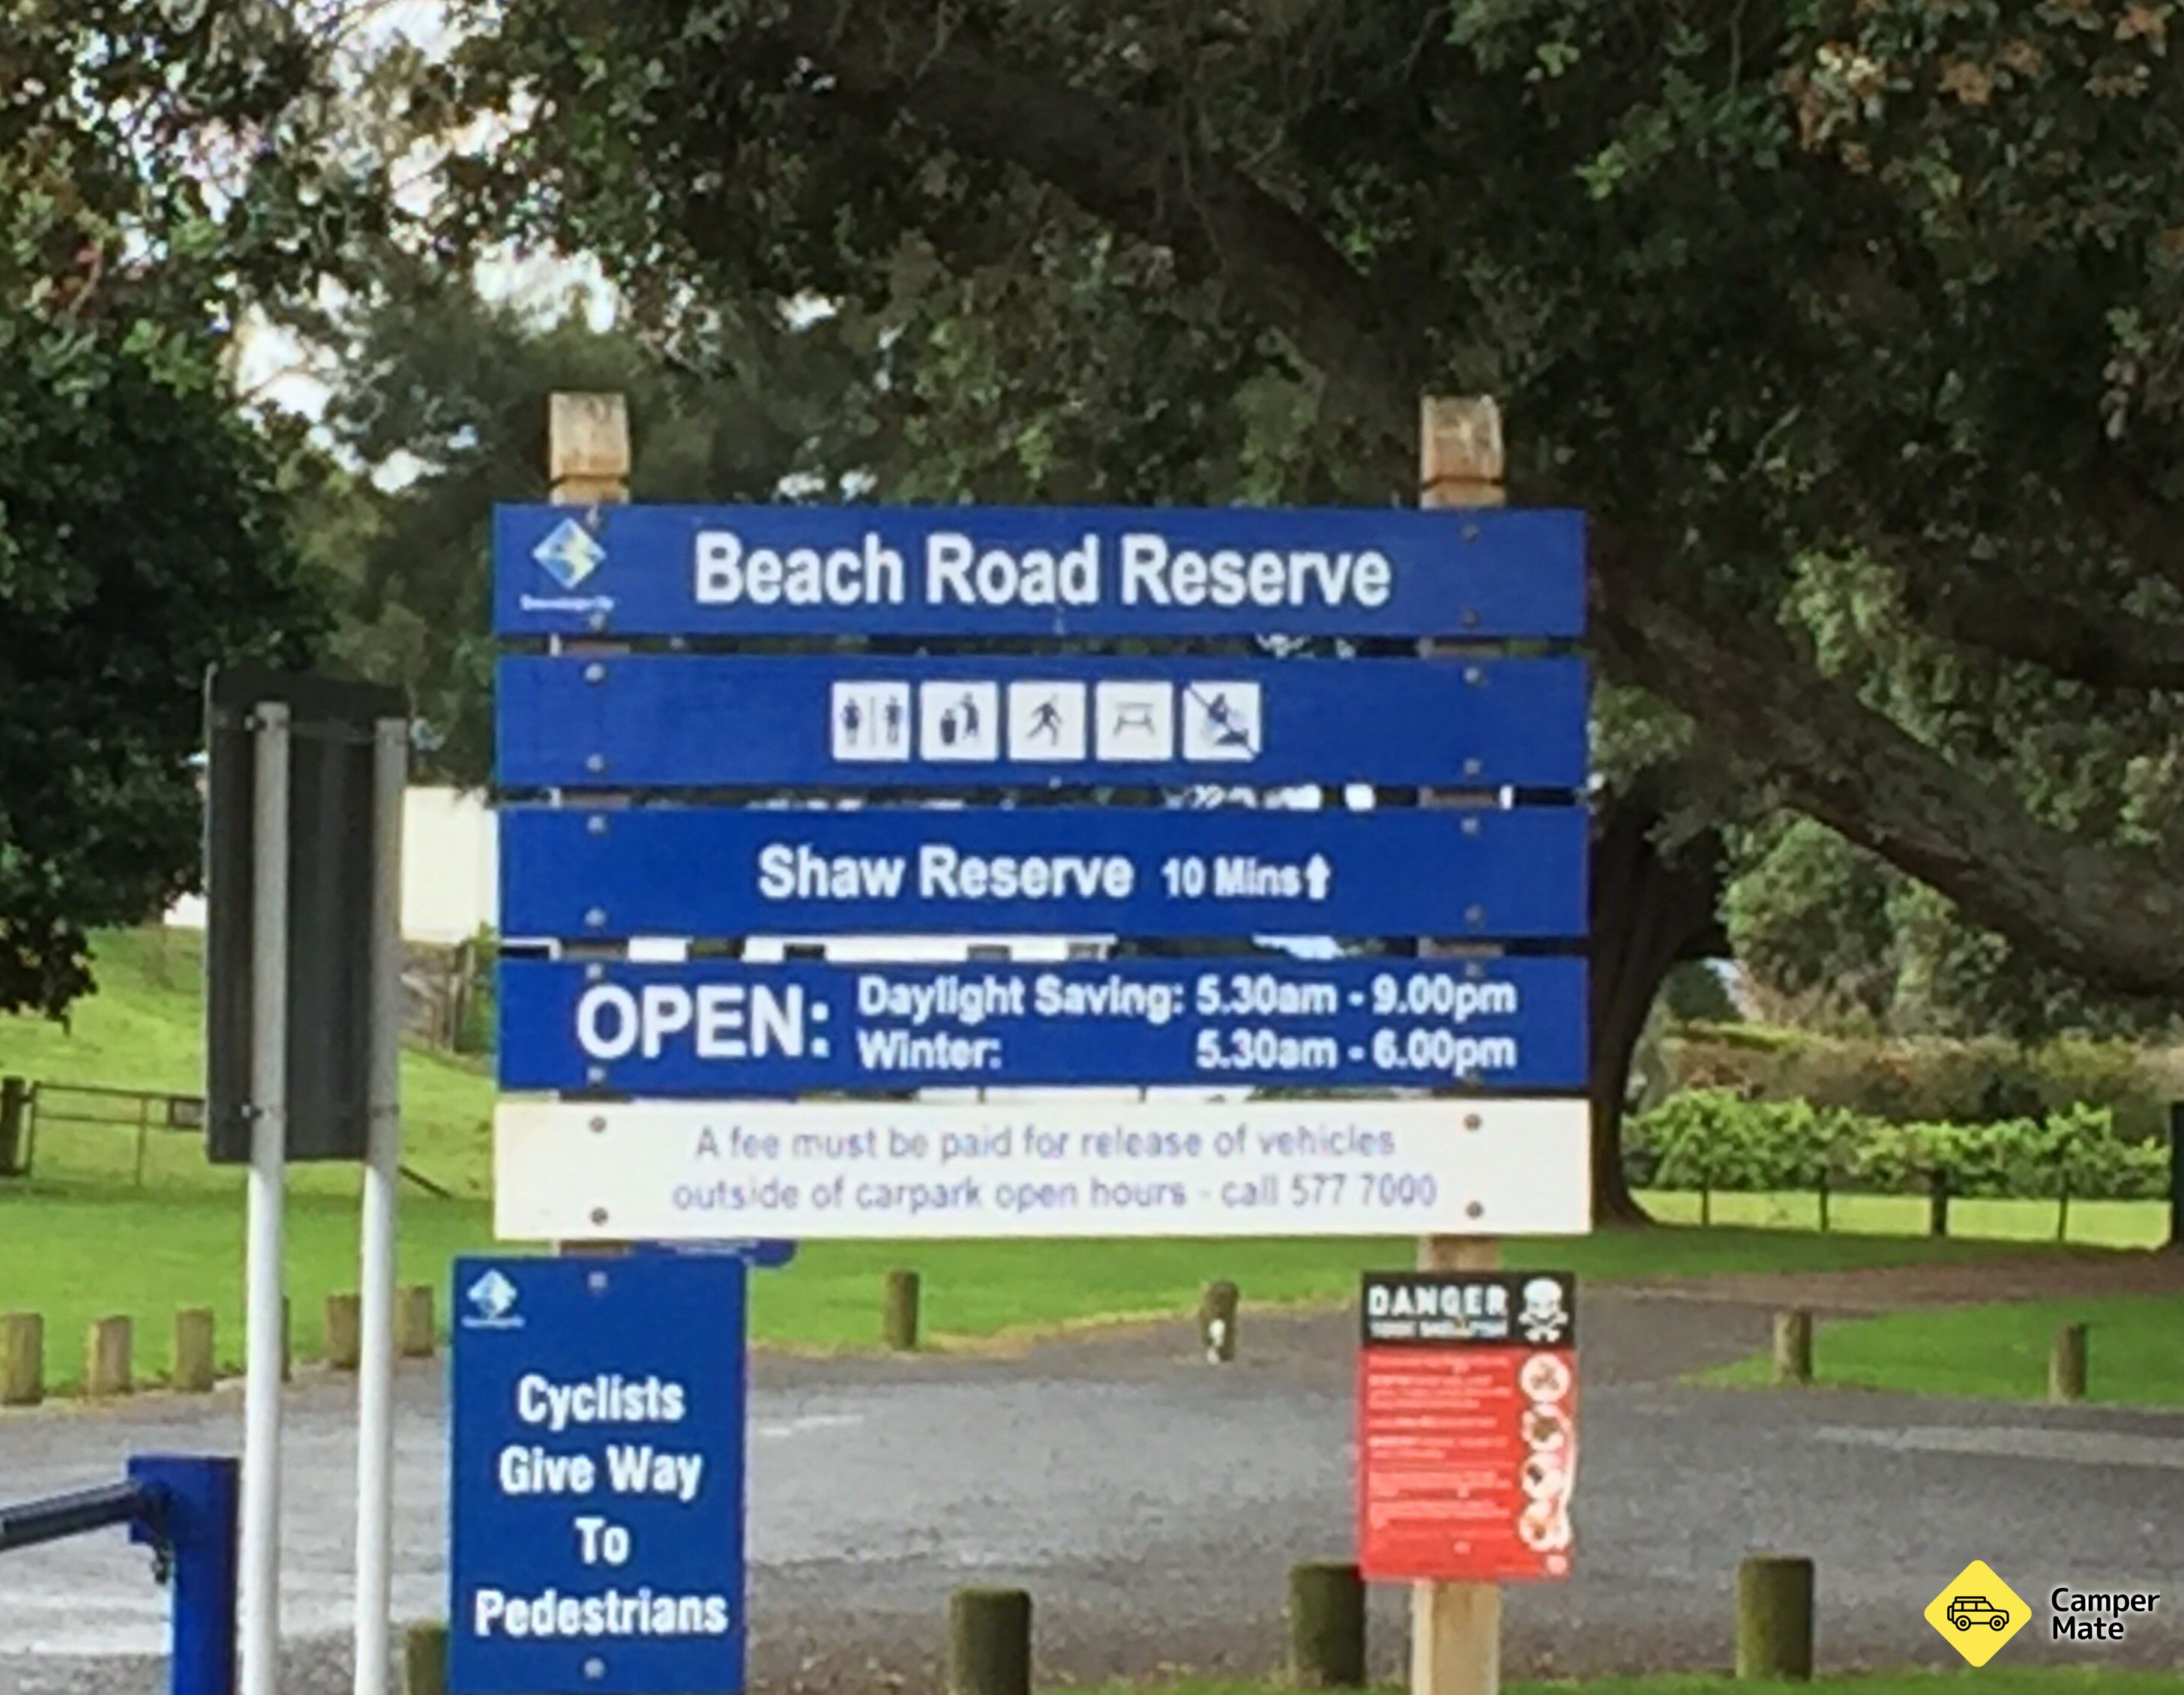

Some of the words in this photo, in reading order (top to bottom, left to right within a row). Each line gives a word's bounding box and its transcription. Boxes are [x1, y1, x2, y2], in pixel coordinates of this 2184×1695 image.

[694, 530, 904, 606] Beach
[926, 532, 1100, 606] Road
[1121, 533, 1392, 607] Reserve
[759, 843, 906, 899] Shaw
[919, 845, 1134, 899] Reserve
[1163, 856, 1206, 897] 10
[1214, 855, 1300, 899] Mins
[576, 984, 829, 1060] OPEN:
[858, 974, 1025, 1025] Daylight
[1035, 974, 1183, 1024] Saving:
[1197, 975, 1338, 1015] 5.30am
[1349, 992, 1365, 1006] -
[1373, 975, 1517, 1023] 9.00pm
[858, 1030, 1002, 1071] Winter:
[1197, 1029, 1338, 1070] 5.30am
[1349, 1046, 1365, 1060] -
[1373, 1029, 1517, 1075] 6.00pm
[697, 1127, 719, 1157] A
[729, 1126, 780, 1158] fee
[792, 1129, 877, 1158] must
[889, 1128, 928, 1158] be
[942, 1126, 1012, 1164] paid
[1023, 1125, 1070, 1158] for
[1082, 1126, 1202, 1158] release
[1213, 1123, 1247, 1157] of
[1258, 1125, 1395, 1157] vehicles
[673, 1179, 798, 1211] outside
[811, 1176, 844, 1209] of
[855, 1178, 981, 1214] carpark
[995, 1183, 1077, 1214] open
[1090, 1178, 1187, 1208] hours
[1221, 1176, 1279, 1207] call
[1292, 1173, 1346, 1207] 577
[1361, 1172, 1437, 1207] 7000
[1368, 1283, 1509, 1316] DANGER
[517, 1373, 686, 1431] Cyclists
[499, 1445, 596, 1494] Give
[605, 1445, 703, 1502] Way
[574, 1517, 630, 1565] To
[474, 1587, 729, 1637] Pedestrians
